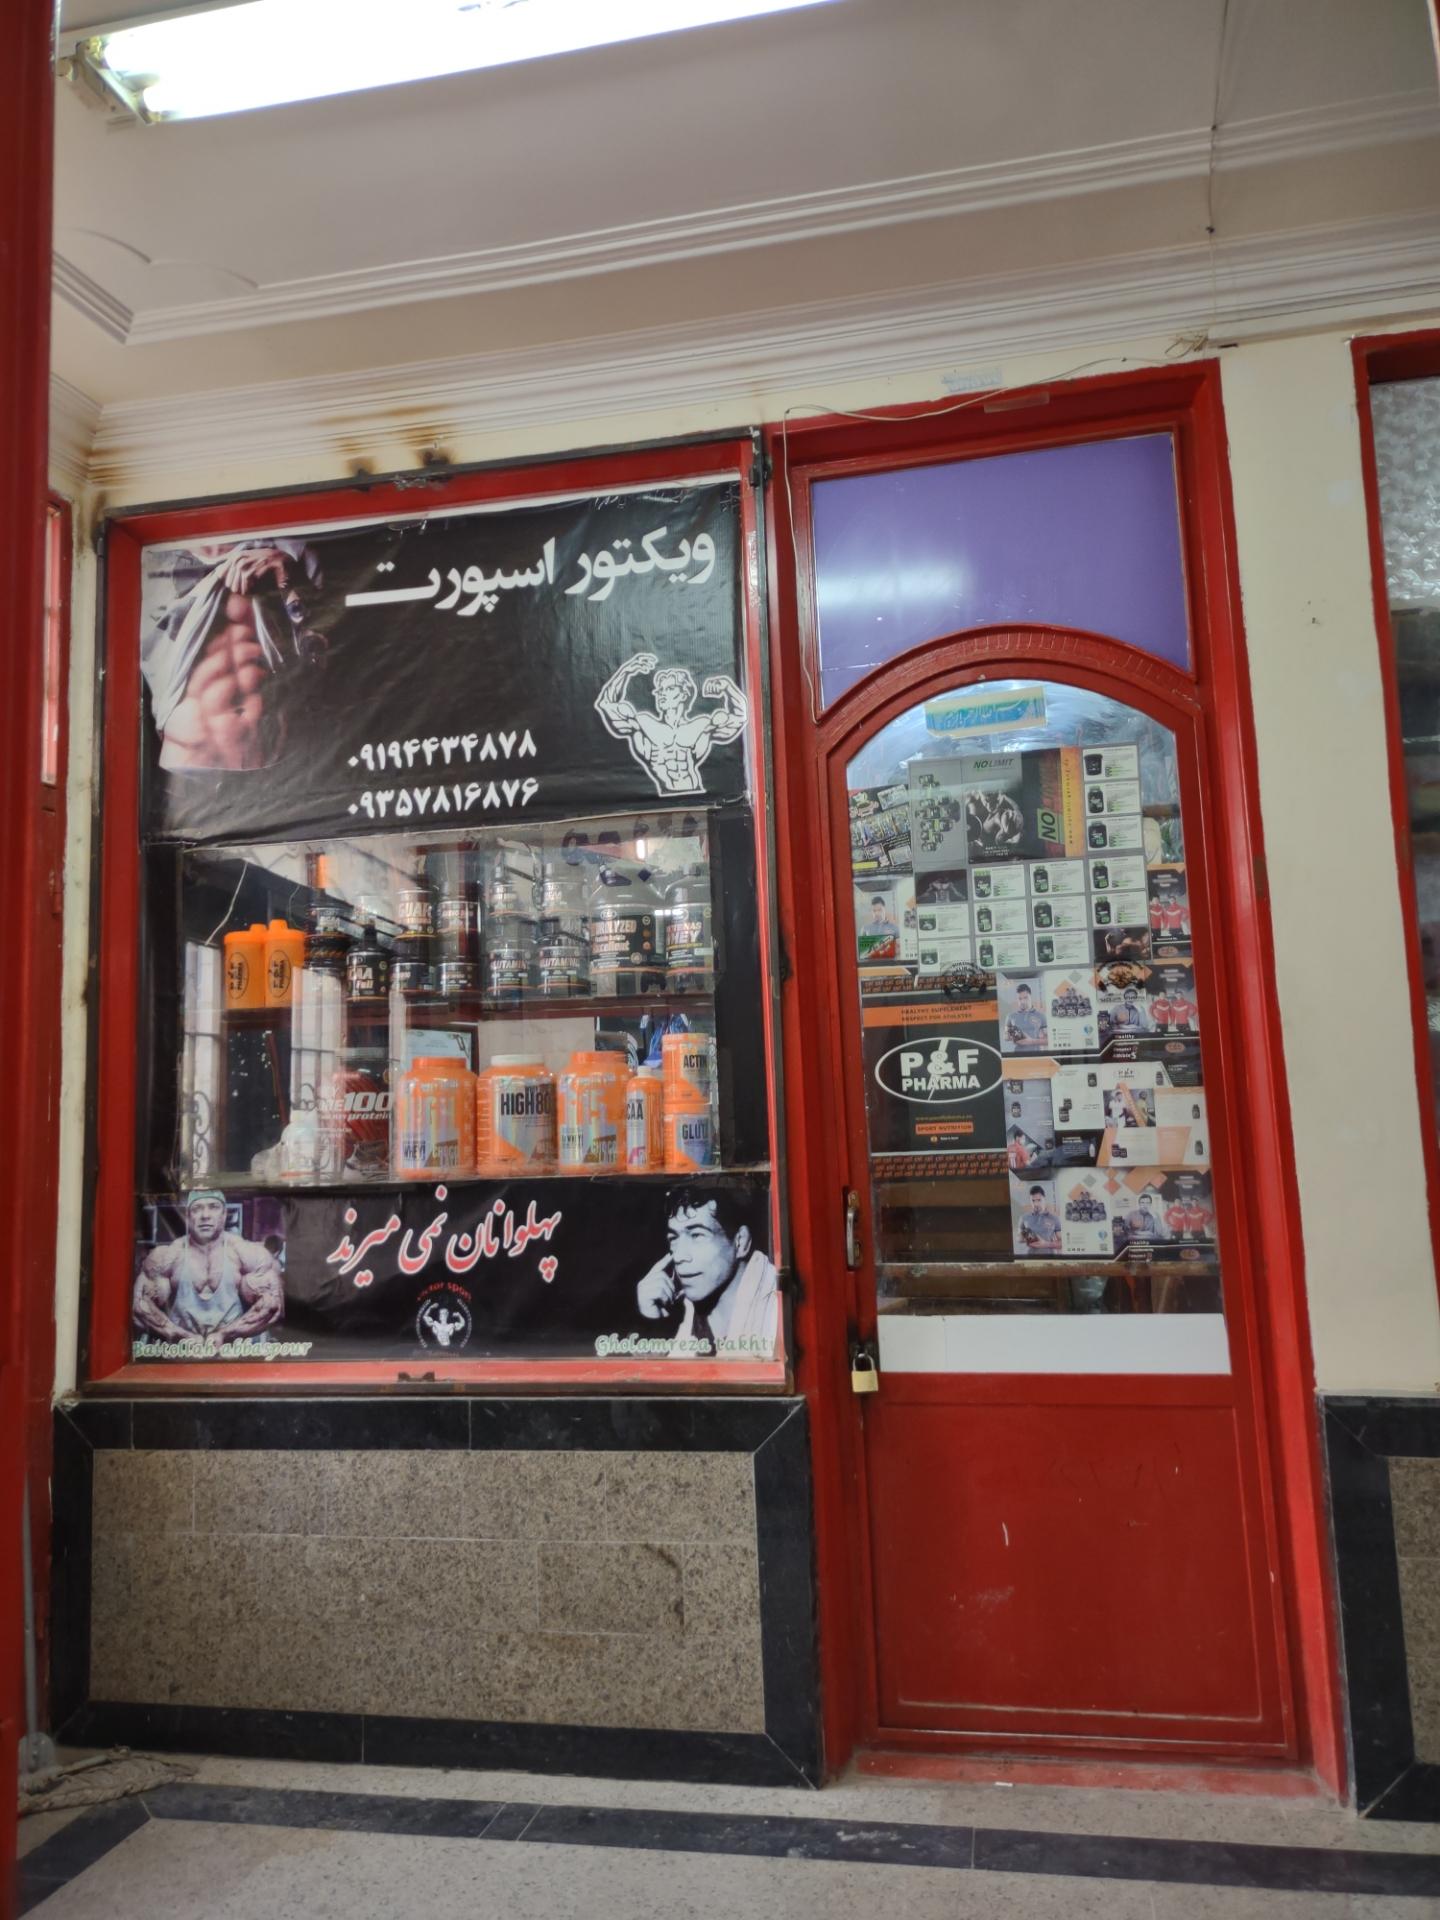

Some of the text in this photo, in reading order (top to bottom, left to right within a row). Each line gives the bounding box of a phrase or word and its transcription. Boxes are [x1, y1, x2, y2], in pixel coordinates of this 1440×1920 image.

[345, 526, 716, 616] ویکتور اسپورت
[348, 729, 537, 771] ۰۹۱۹۴۴۳۴۸۷۸
[348, 777, 539, 819] ۰۹۳۵۷۸۱۶۸۷۶
[902, 1074, 981, 1092] PHARMA
[326, 1184, 562, 1288] پهلوانان نمی میرند
[594, 1332, 712, 1357] Gholamreza
